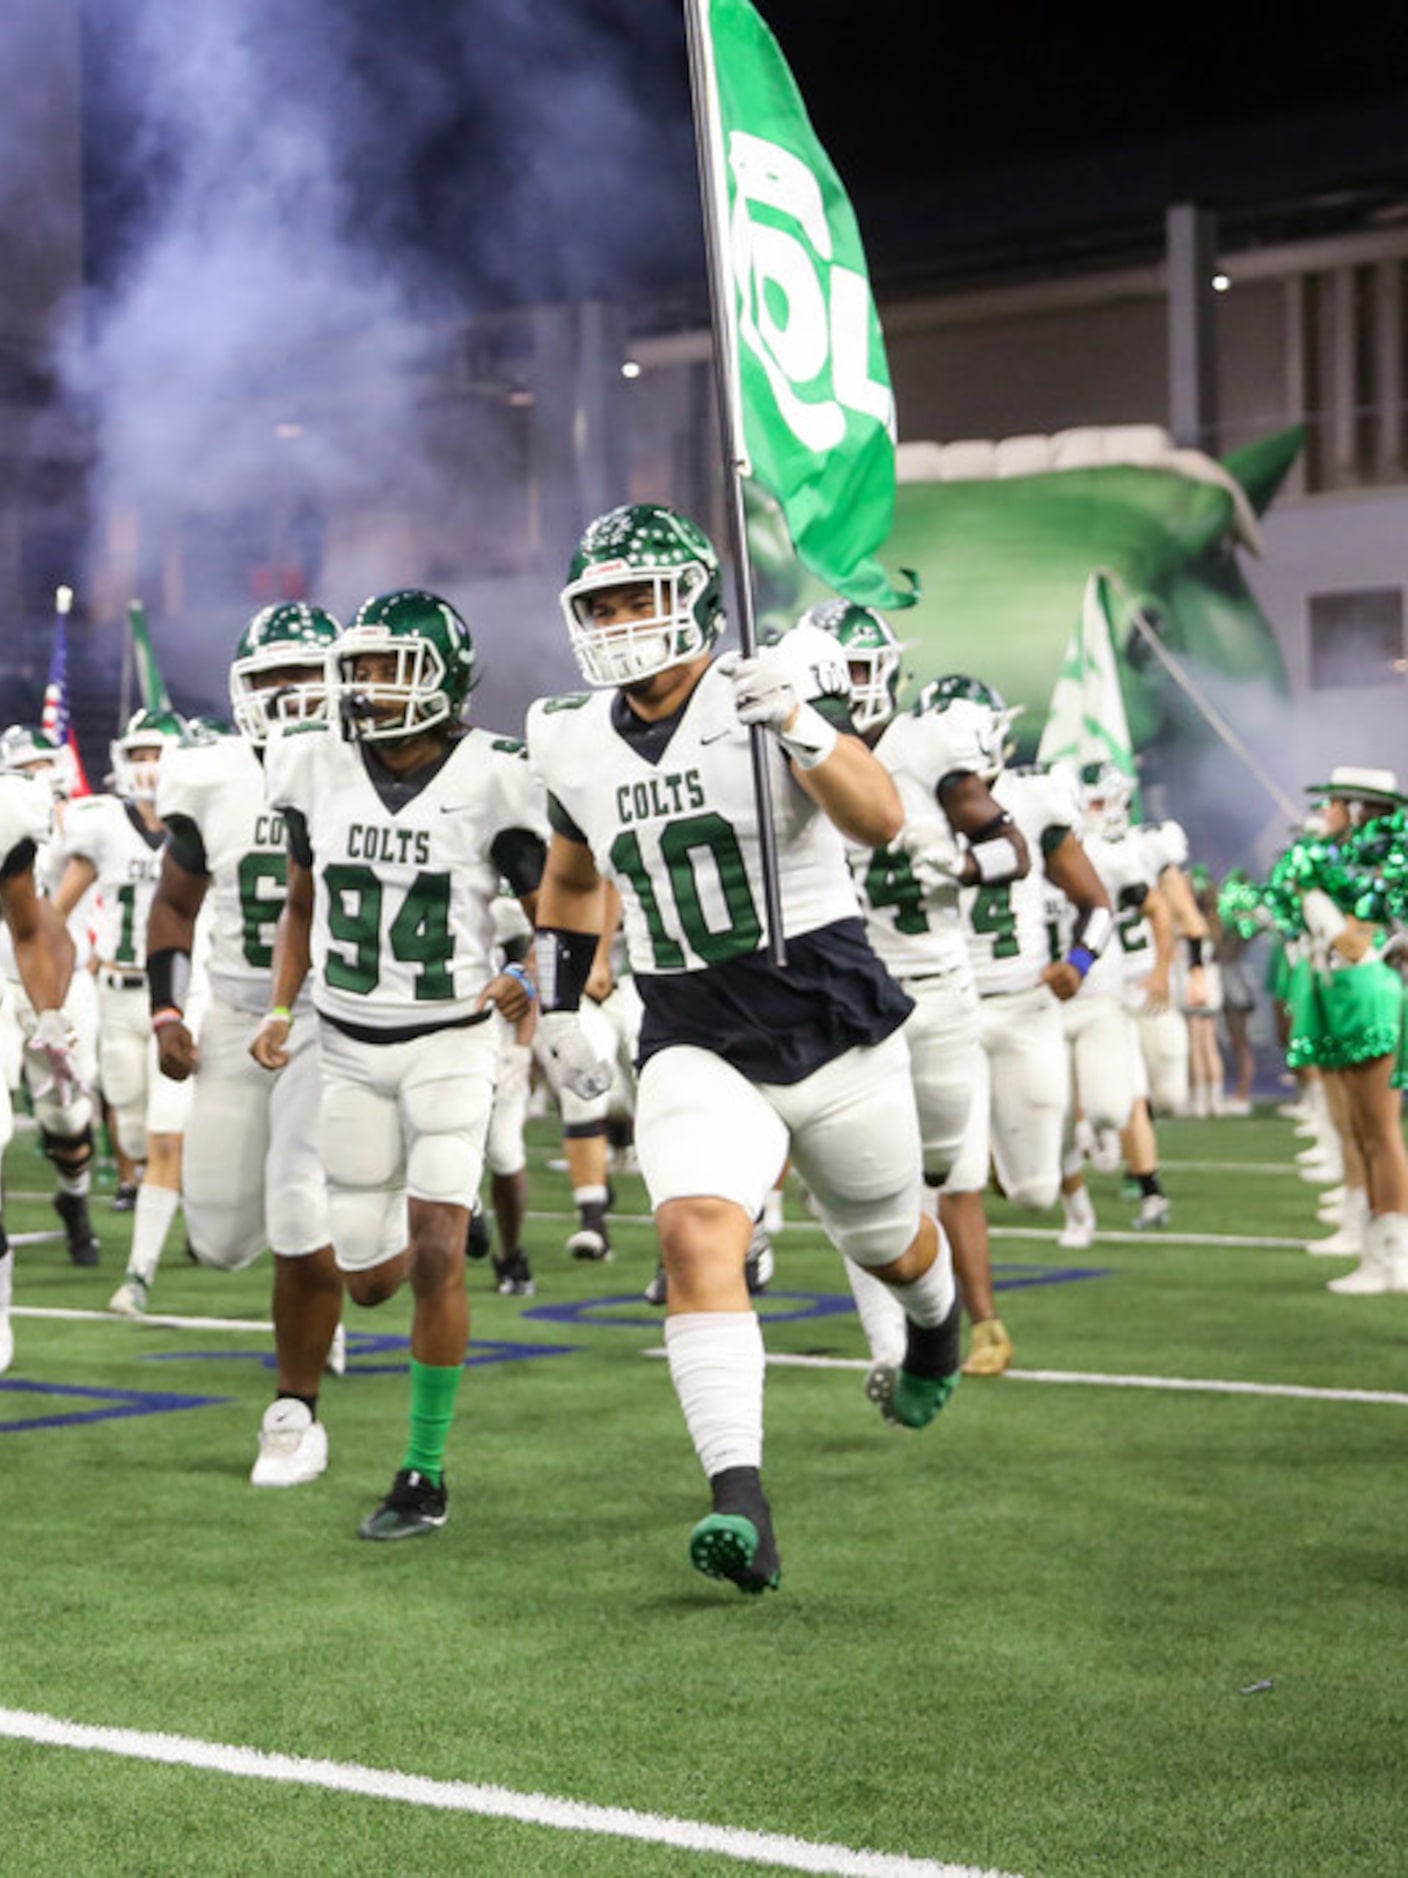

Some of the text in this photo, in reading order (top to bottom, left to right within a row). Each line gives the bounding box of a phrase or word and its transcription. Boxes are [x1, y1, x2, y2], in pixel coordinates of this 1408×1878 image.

[616, 769, 705, 823] COLTS
[348, 824, 430, 864] COLTS
[609, 812, 766, 968] 10
[322, 864, 456, 1000] 94
